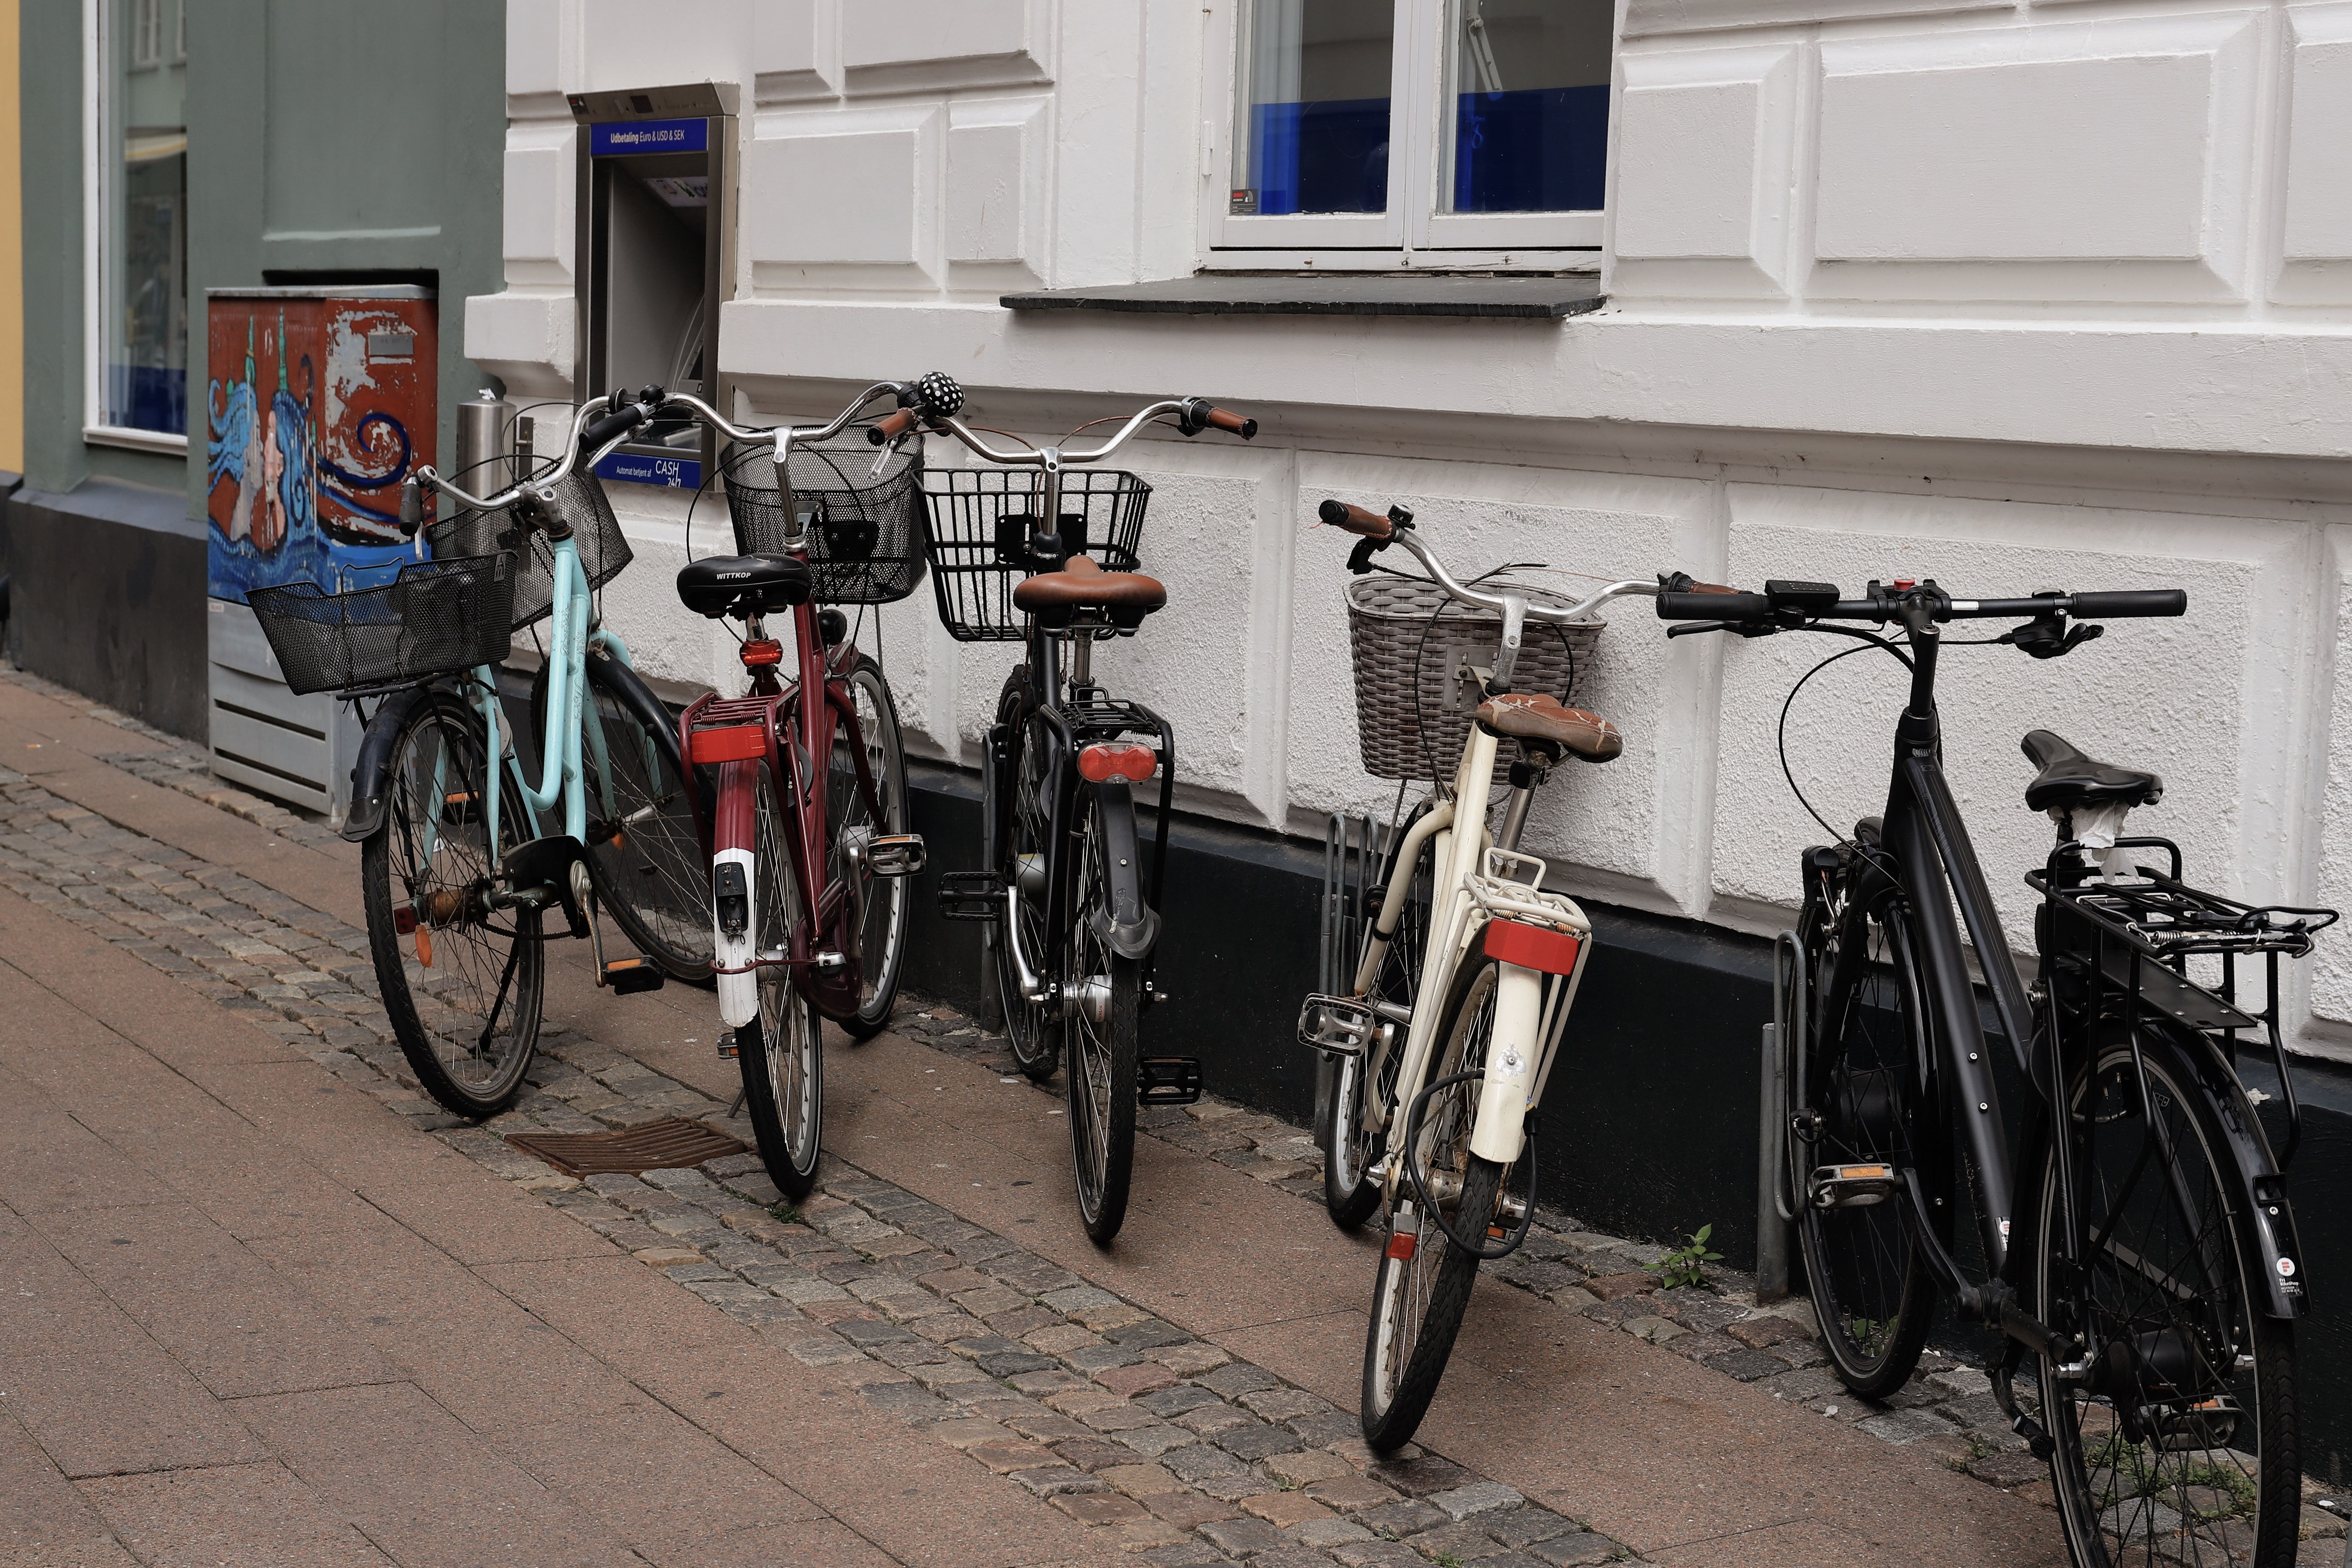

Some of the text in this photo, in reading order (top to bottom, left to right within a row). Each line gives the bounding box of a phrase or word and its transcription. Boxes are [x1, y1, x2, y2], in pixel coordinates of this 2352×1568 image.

[611, 129, 684, 144] Udbetaling Euro & USD & SEK
[616, 466, 652, 478] Automat betjent af
[655, 460, 679, 476] CASH
